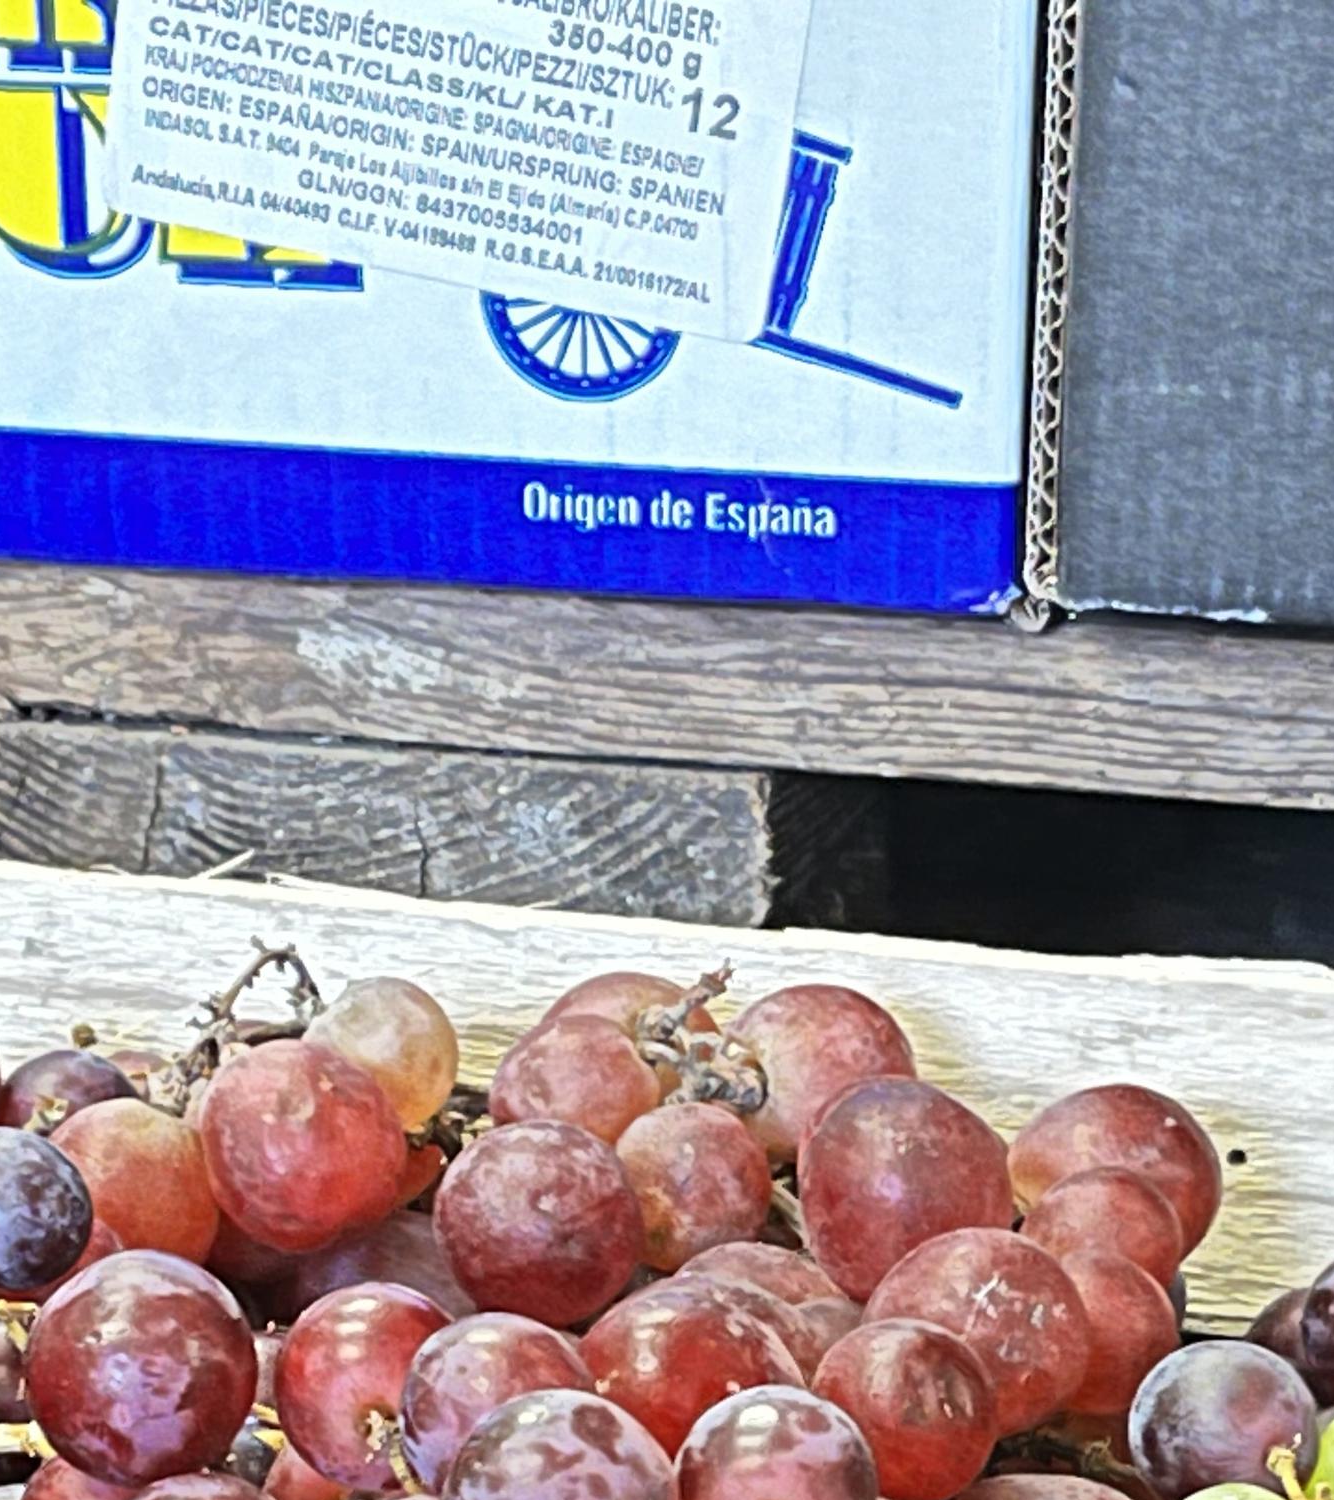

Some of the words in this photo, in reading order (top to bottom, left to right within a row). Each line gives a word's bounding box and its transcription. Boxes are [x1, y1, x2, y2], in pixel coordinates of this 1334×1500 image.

[145, 43, 188, 72] KRAJ
[191, 53, 303, 96] POCHODZENIA
[548, 18, 673, 68] 350-400
[682, 51, 703, 80] g
[144, 108, 213, 141] INDASOL
[218, 123, 262, 151] S.A.T.
[309, 141, 355, 172] Paraje
[359, 152, 385, 177] Los
[680, 87, 741, 140] 12
[142, 76, 232, 113] ORIGEN:
[239, 94, 414, 153] ESPAÑA/ORIGIN:
[421, 133, 622, 195] SPAIN/URSPRUNG:
[628, 176, 725, 216] SPANIEN
[522, 479, 641, 533] Origen
[649, 488, 694, 530] de
[705, 491, 838, 541] España
